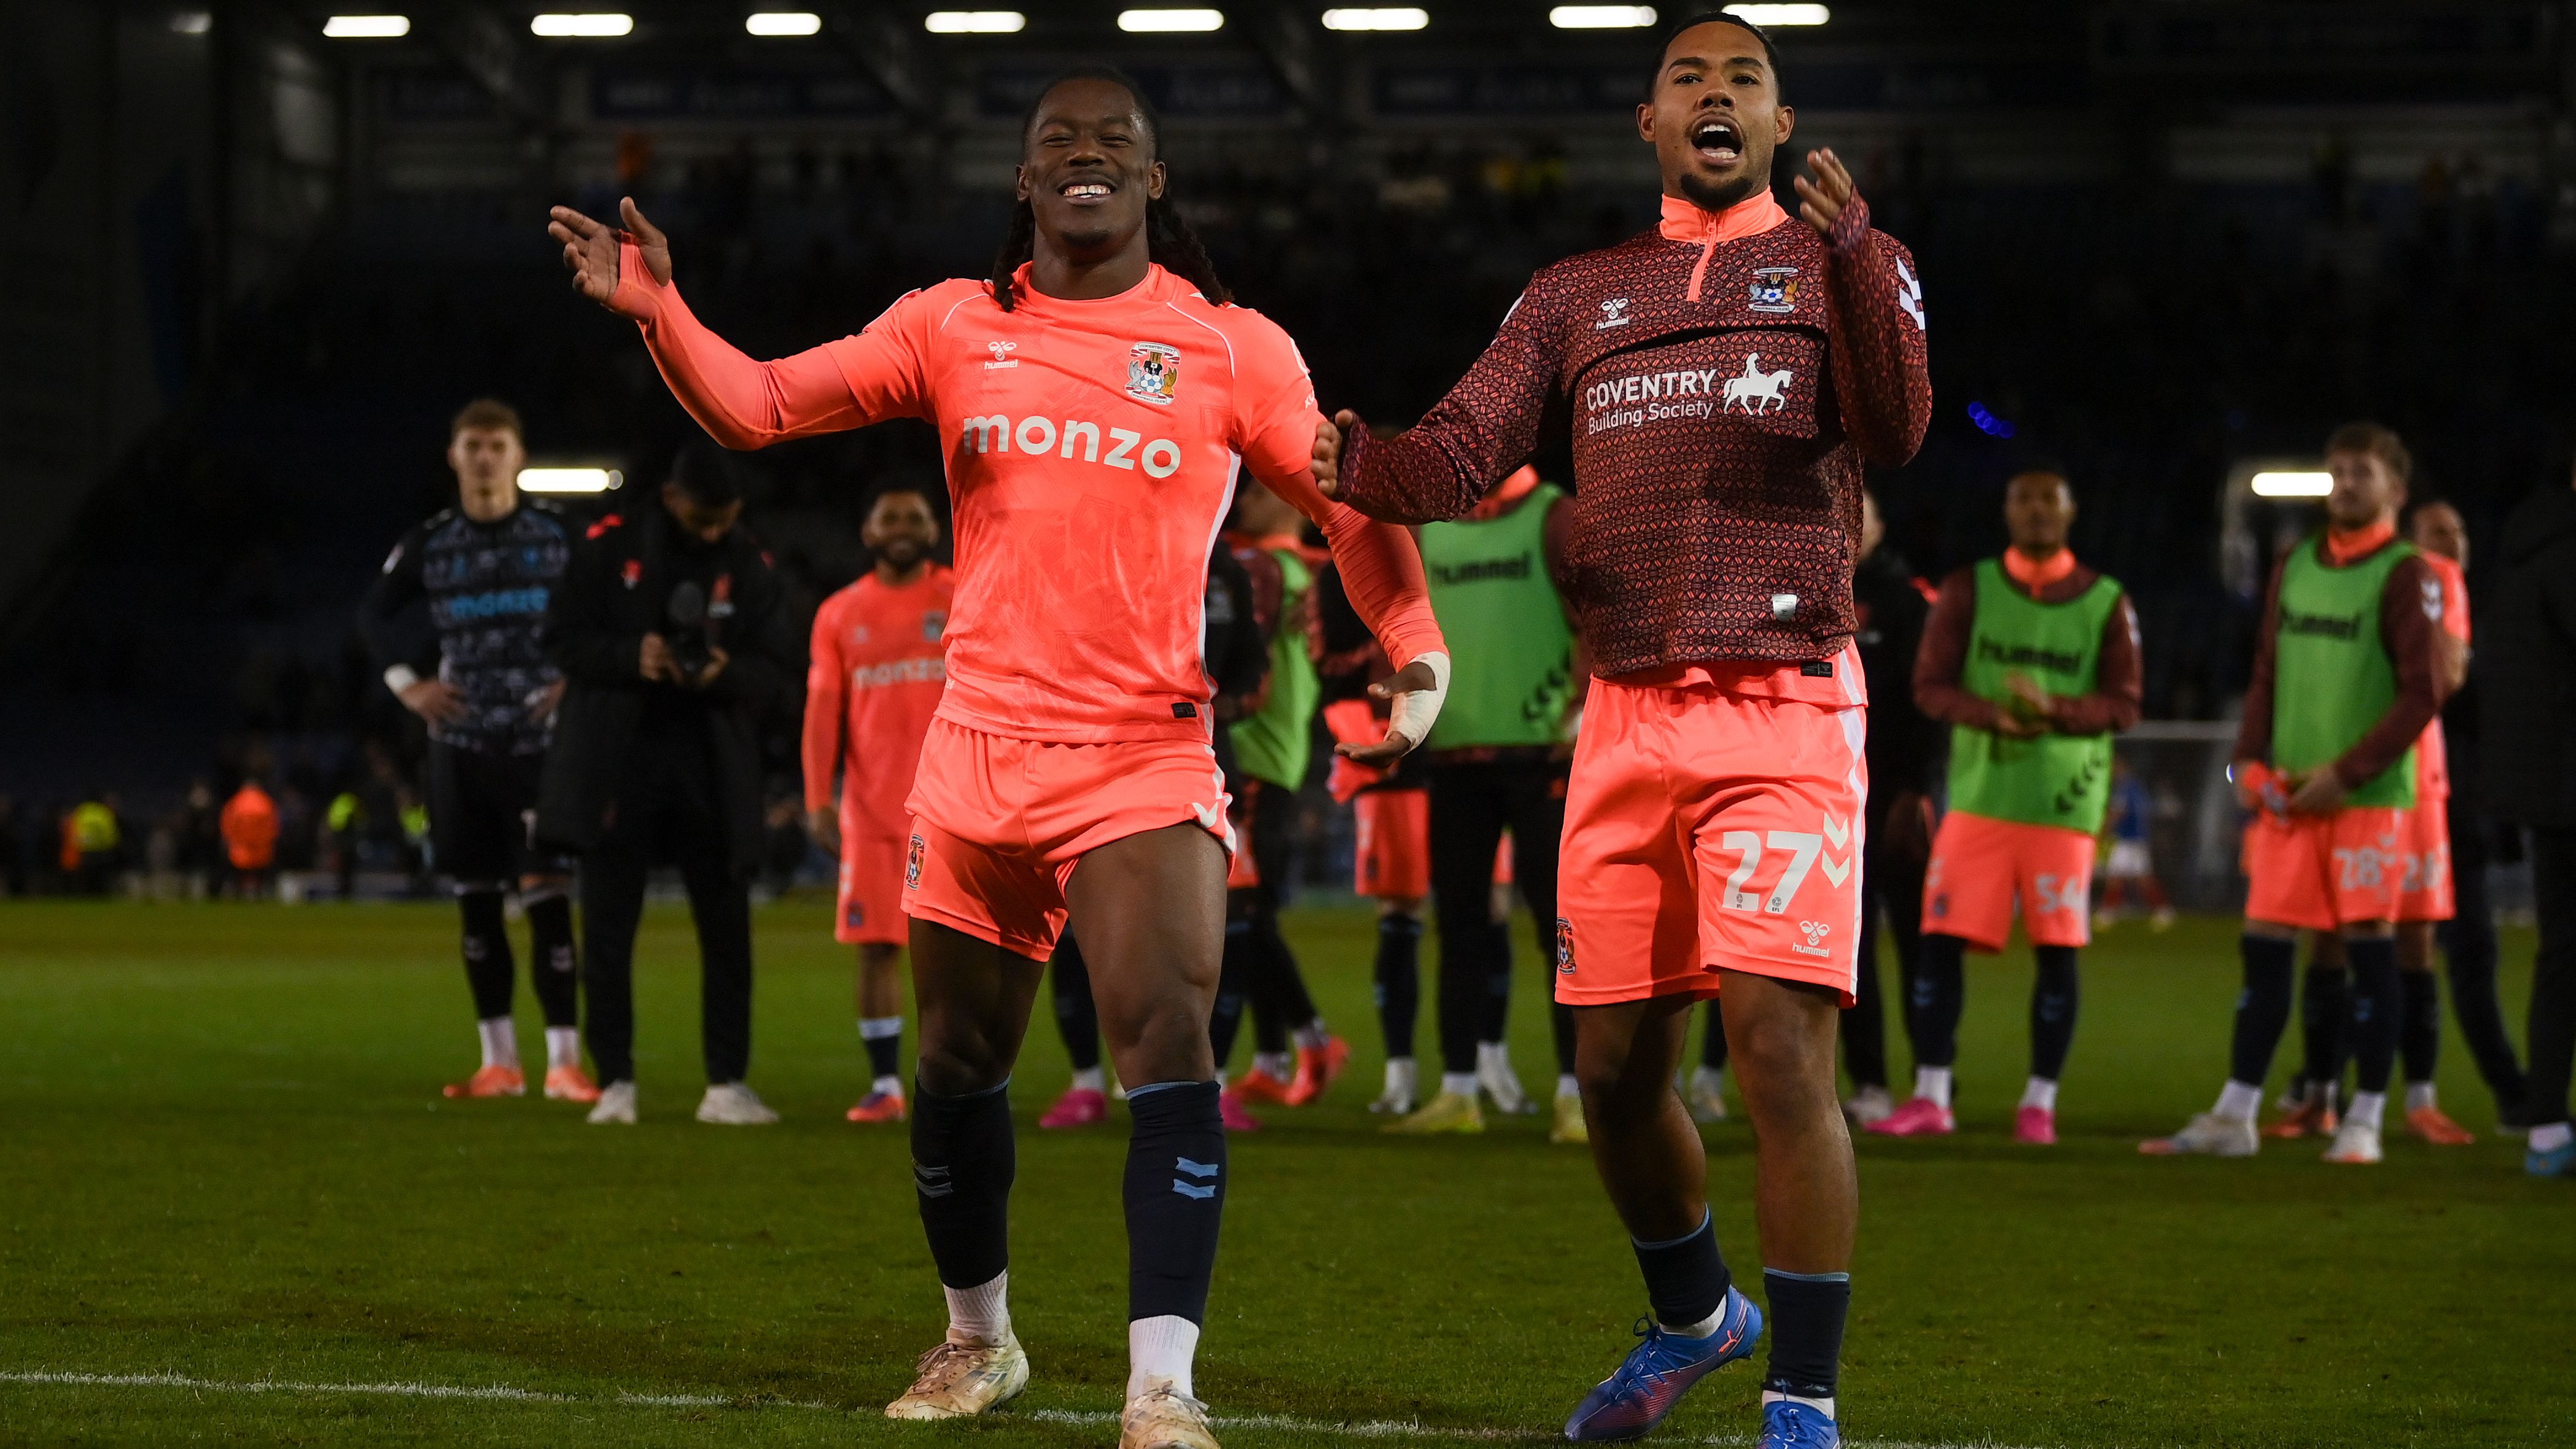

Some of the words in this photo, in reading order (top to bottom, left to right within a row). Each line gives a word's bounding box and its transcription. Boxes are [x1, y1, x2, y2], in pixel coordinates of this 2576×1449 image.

[1596, 316, 1629, 330] hummel
[984, 359, 1018, 370] hummel
[1587, 369, 1718, 411] COVENTRY
[1588, 409, 1643, 435] Building
[1648, 400, 1714, 422] Society
[963, 414, 1181, 479] monzo
[1722, 830, 1823, 914] 27
[2335, 847, 2381, 890] 28
[2036, 874, 2088, 914] 54
[1792, 942, 1829, 958] hummel
